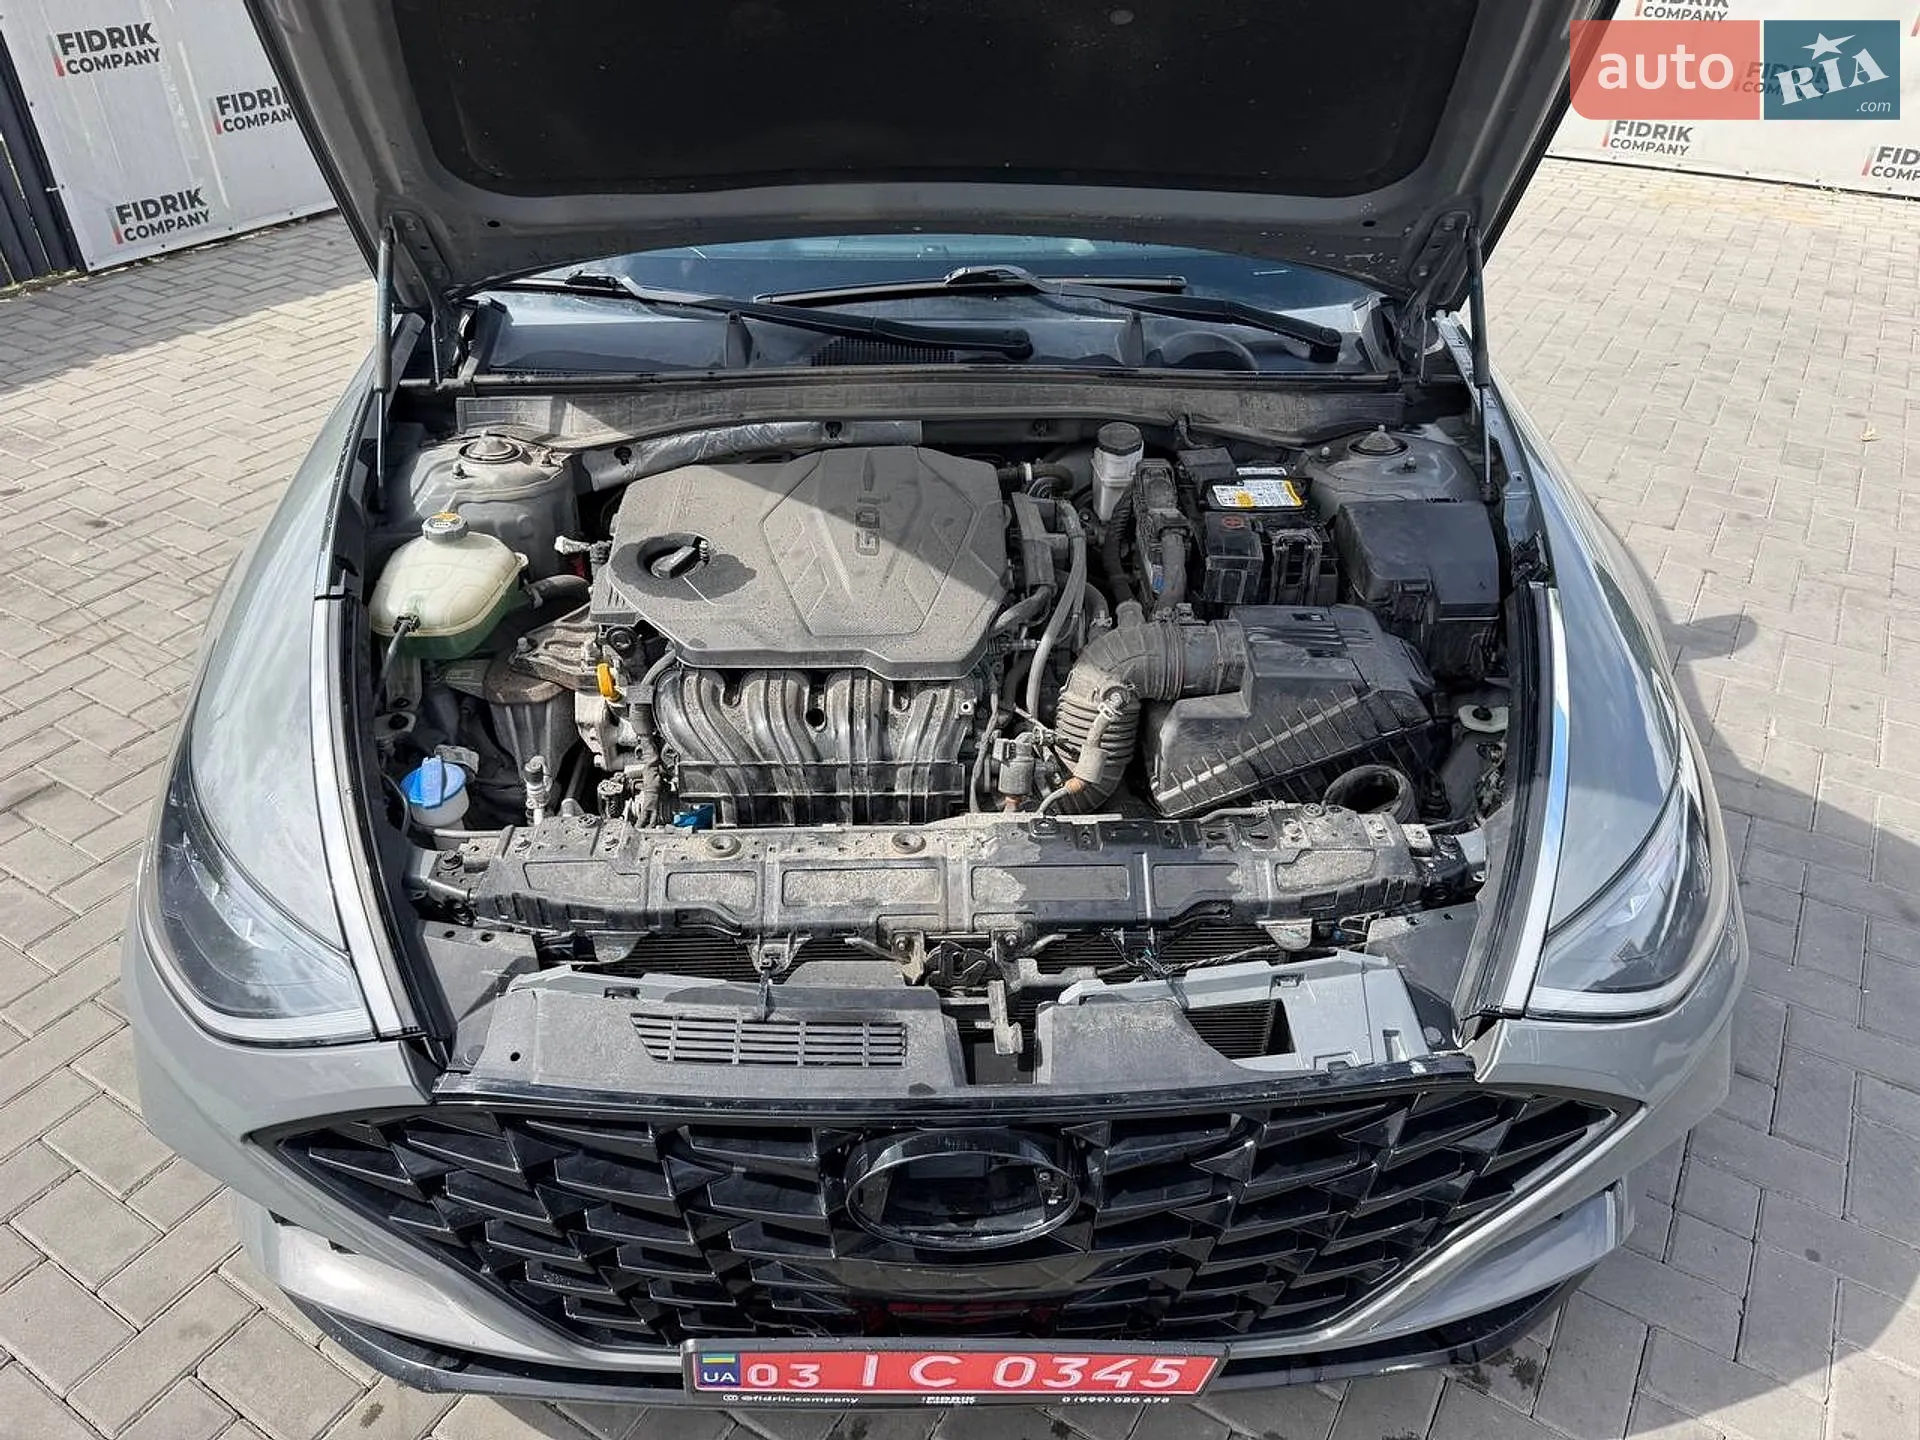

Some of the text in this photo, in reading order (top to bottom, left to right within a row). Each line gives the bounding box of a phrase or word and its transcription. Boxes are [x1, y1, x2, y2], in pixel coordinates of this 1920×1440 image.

[1643, 6, 1728, 22] COMPANY
[56, 22, 157, 55] FIDRIK
[66, 48, 160, 74] COMPANY
[1614, 120, 1693, 143] FIDRIK
[1610, 138, 1689, 156] COMPANY
[116, 188, 207, 225] FIDRIK
[124, 210, 209, 241] COMPANY
[703, 1372, 736, 1383] UA
[748, 1362, 820, 1388] 03
[993, 1356, 1188, 1388] 0345
